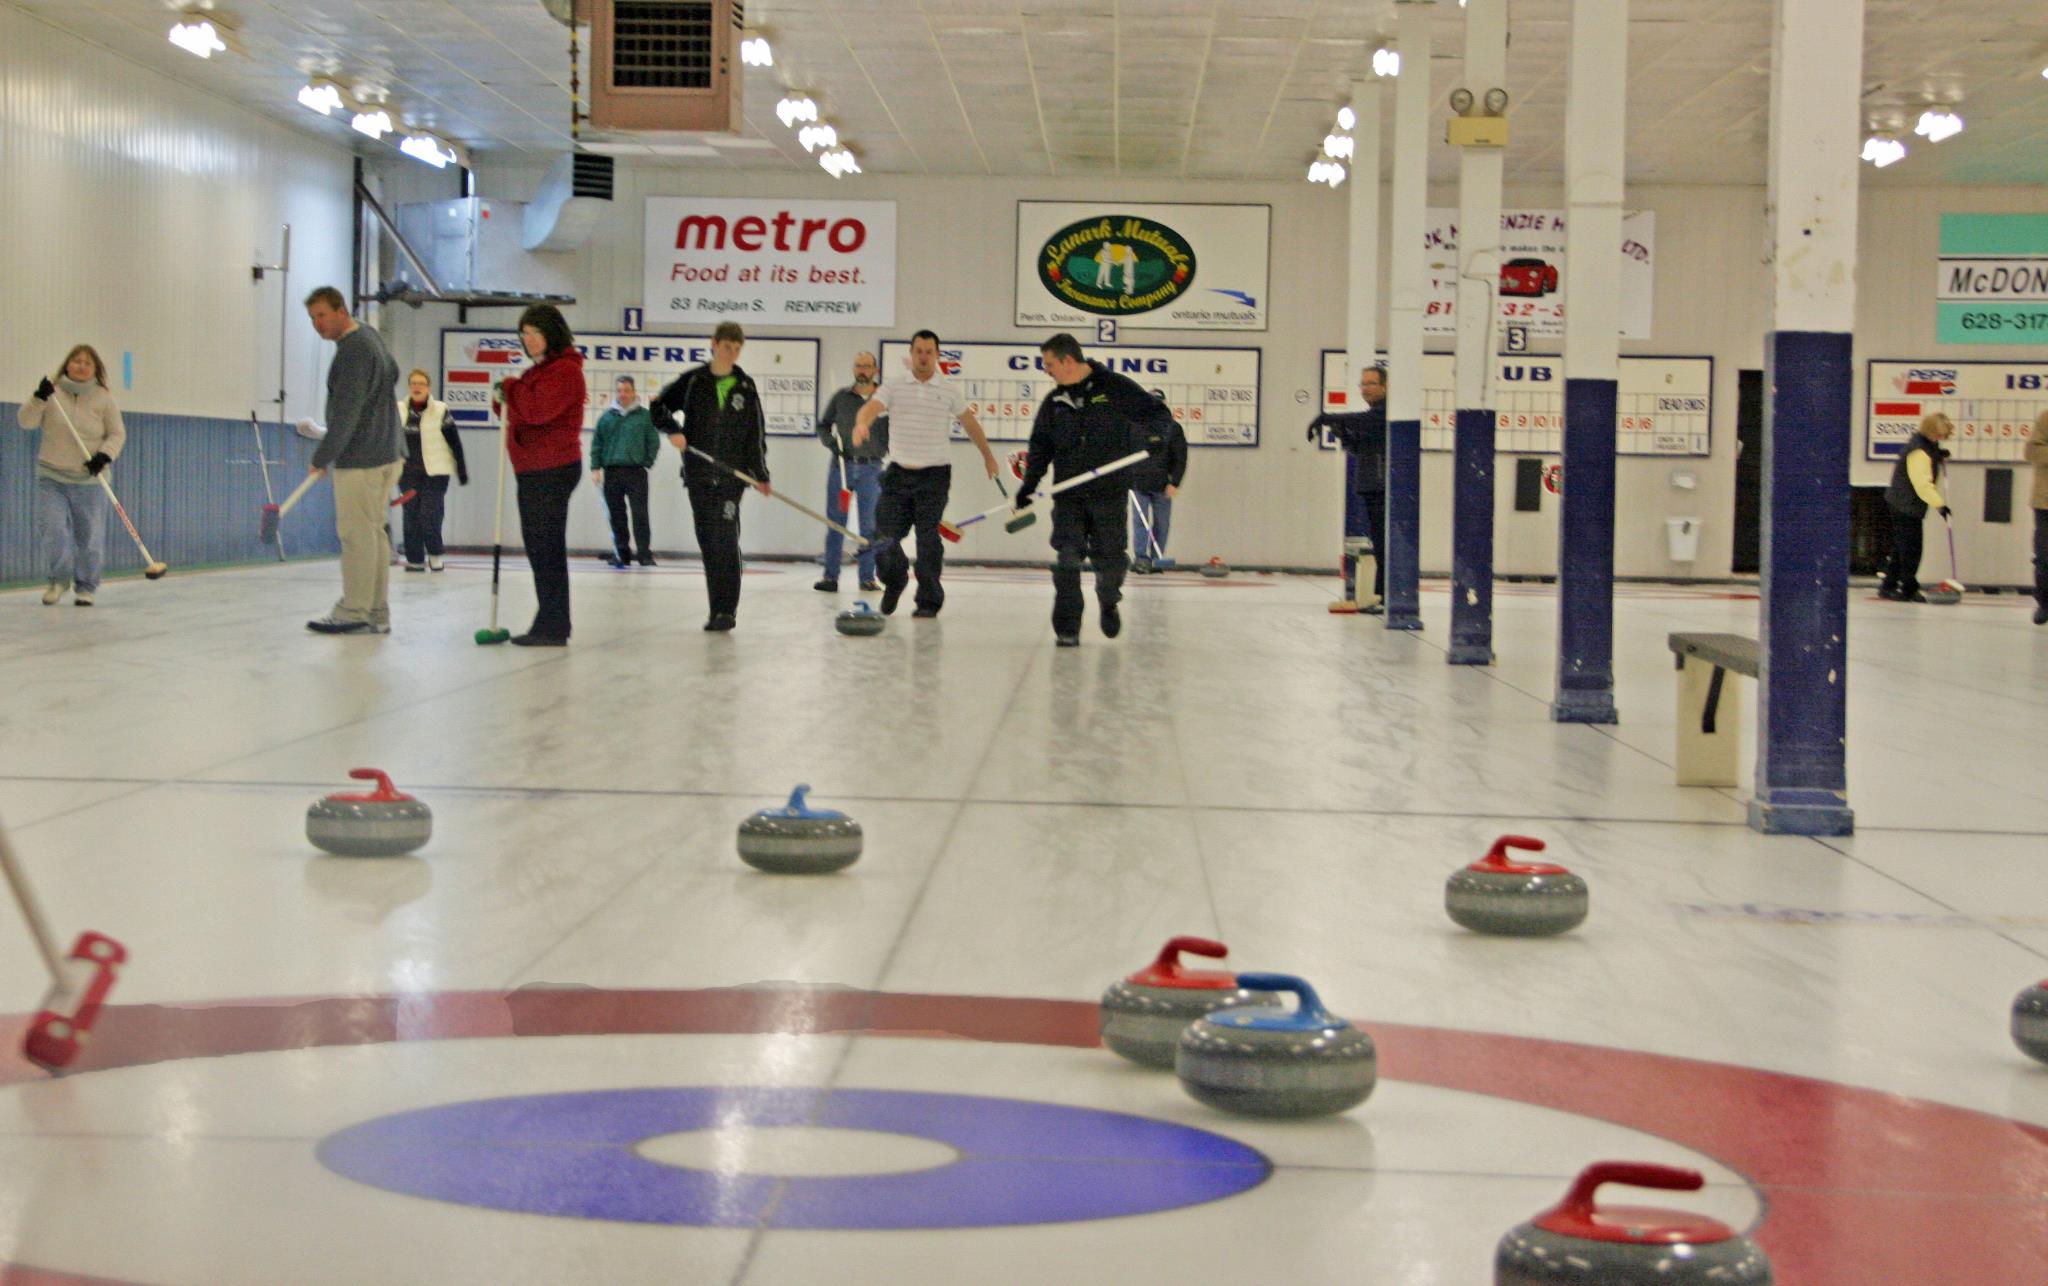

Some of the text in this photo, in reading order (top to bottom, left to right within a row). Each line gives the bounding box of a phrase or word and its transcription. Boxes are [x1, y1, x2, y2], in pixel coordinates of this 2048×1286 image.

[1500, 213, 1545, 231] ENZIE
[675, 211, 867, 254] metro
[1048, 218, 1190, 265] Lanark Mutual
[671, 263, 866, 285] Food at its best.
[1056, 278, 1178, 309] Insurance Company
[670, 298, 691, 311] 83
[697, 298, 749, 314] Raglan
[784, 300, 861, 313] RENFREW
[1171, 309, 1211, 320] ontario
[1961, 312, 2048, 330] 628-317
[576, 344, 714, 364] RENFRE
[1908, 369, 1957, 381] PEPSI
[2006, 373, 2048, 390] 18
[448, 390, 487, 402] SCORE
[1021, 383, 1031, 398] 3
[987, 403, 997, 416] 4
[1003, 403, 1013, 416] 5
[1020, 403, 1030, 417] 6
[1430, 414, 1440, 425] 4
[1499, 415, 1510, 428] 8
[1517, 415, 1527, 428] 9
[1533, 415, 1547, 429] 10
[1621, 416, 1652, 430] 15 16
[1965, 423, 1975, 437] 3
[1983, 423, 1994, 437] 4
[2001, 423, 2012, 437] 5
[2019, 423, 2030, 437] 6
